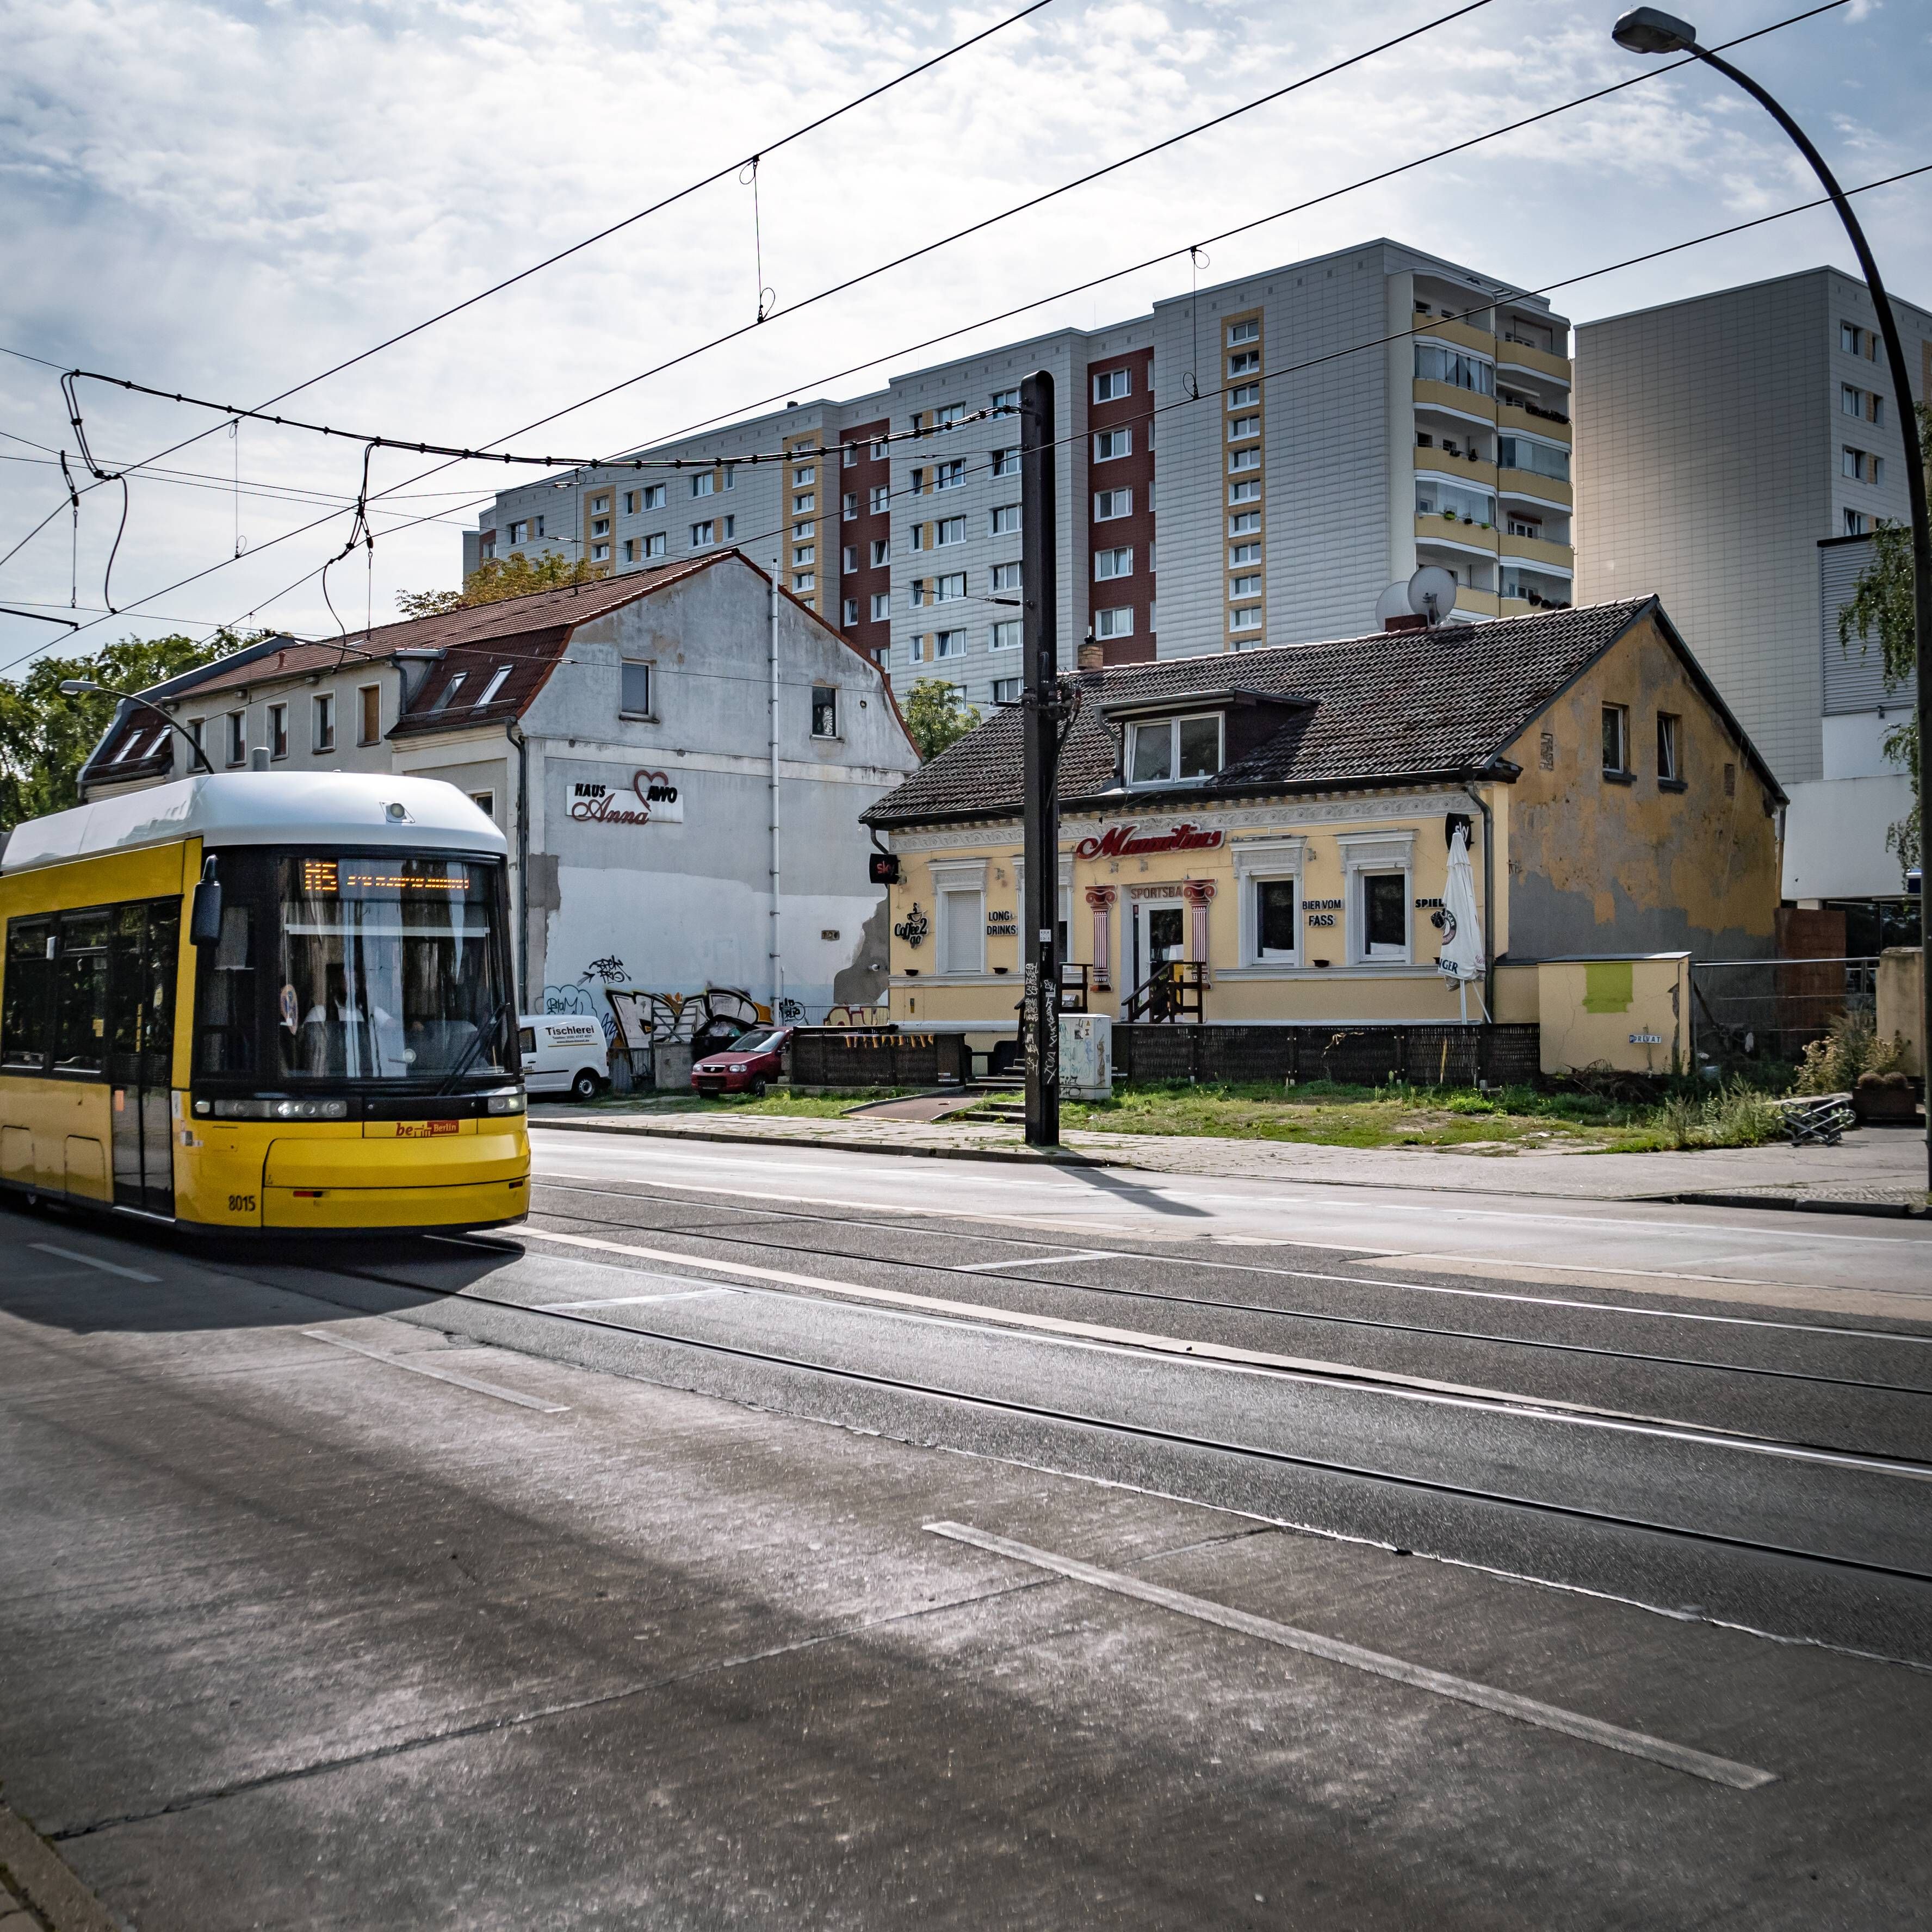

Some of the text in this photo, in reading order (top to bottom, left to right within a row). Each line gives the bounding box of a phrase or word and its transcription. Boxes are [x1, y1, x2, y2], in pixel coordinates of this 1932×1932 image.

[575, 783, 606, 797] HAUS
[646, 785, 677, 803] AWO
[572, 792, 649, 825] Anna
[1454, 821, 1469, 843] sky
[1131, 886, 1182, 899] SPORTSBA
[1302, 900, 1341, 909] BIER VOM
[988, 911, 1010, 921] LONG
[1309, 915, 1333, 926] FASS
[987, 925, 1016, 935] DRINKS
[546, 1025, 595, 1035] Tischlerei
[396, 1122, 457, 1136] be Berlin
[228, 1196, 256, 1211] 8015
